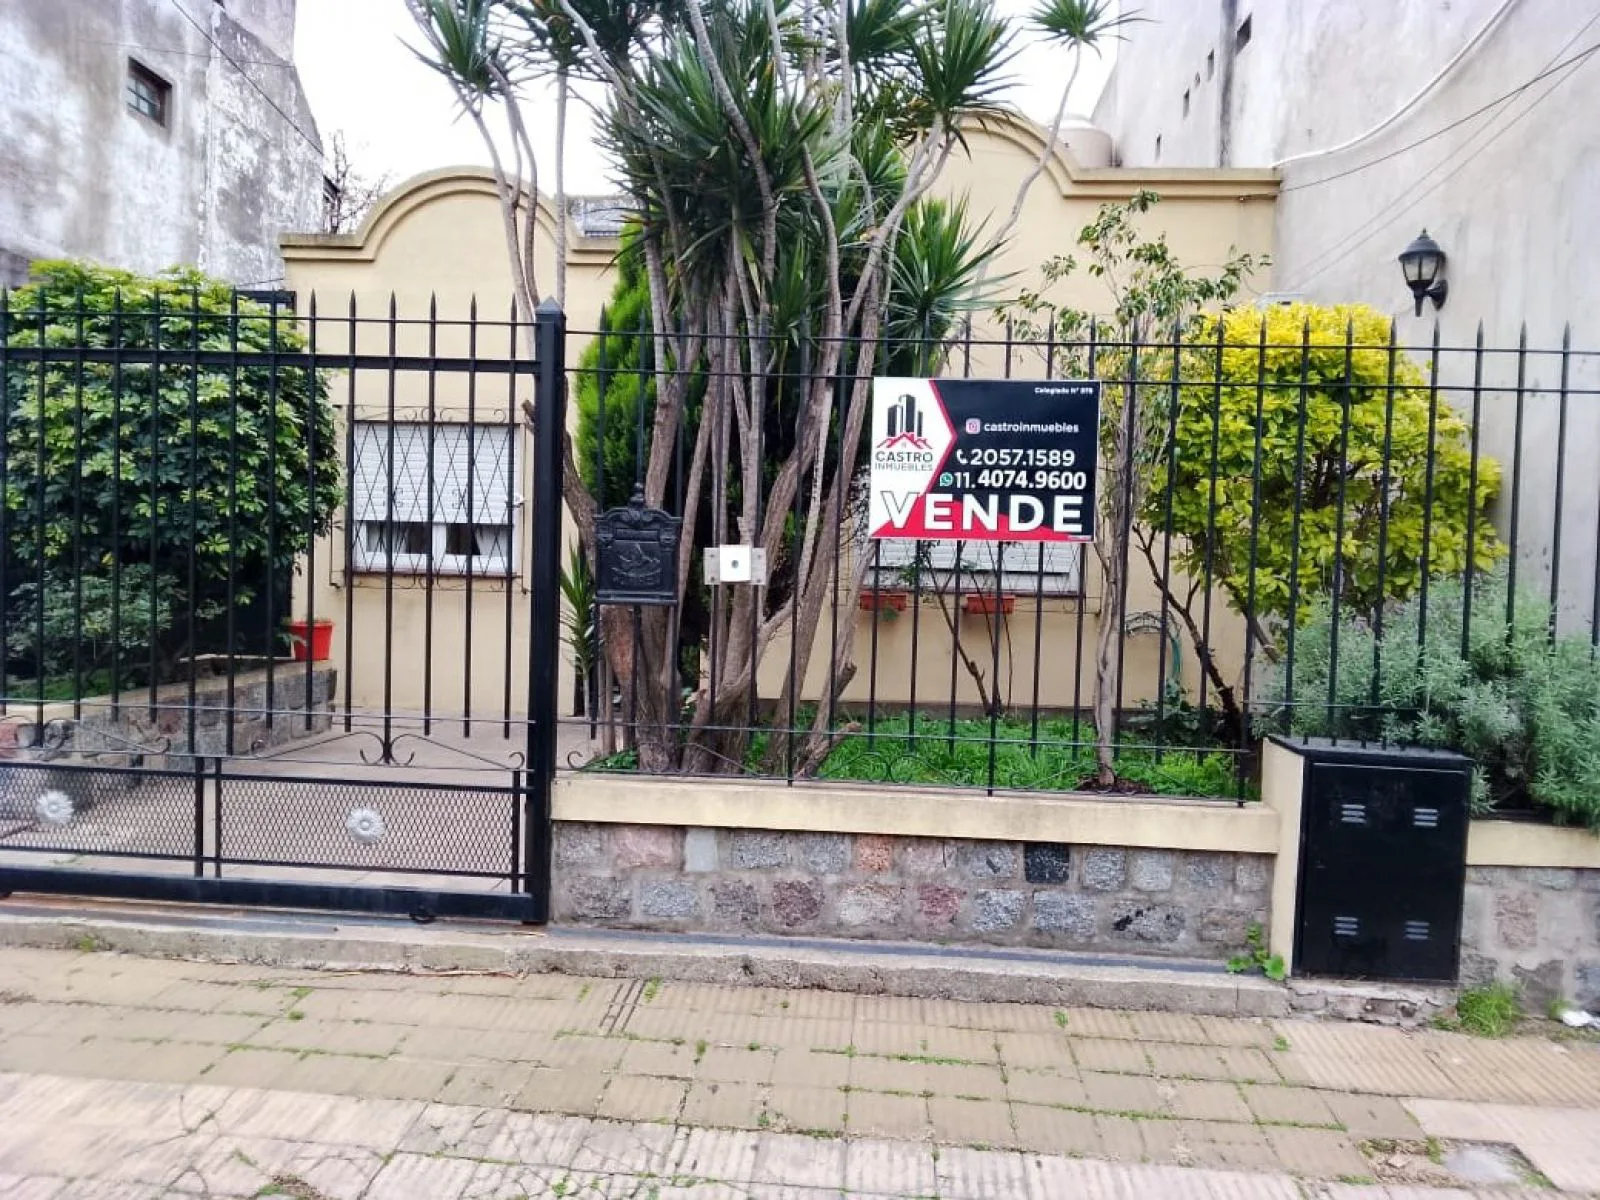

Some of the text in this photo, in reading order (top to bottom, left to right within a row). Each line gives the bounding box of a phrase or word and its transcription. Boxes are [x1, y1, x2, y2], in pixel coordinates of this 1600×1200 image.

[984, 421, 1079, 433] castroinmuebles
[875, 451, 933, 463] CASTRO
[970, 449, 1075, 467] 2057.1589
[875, 463, 933, 472] INMUEBLES
[880, 491, 1083, 533] VENDE
